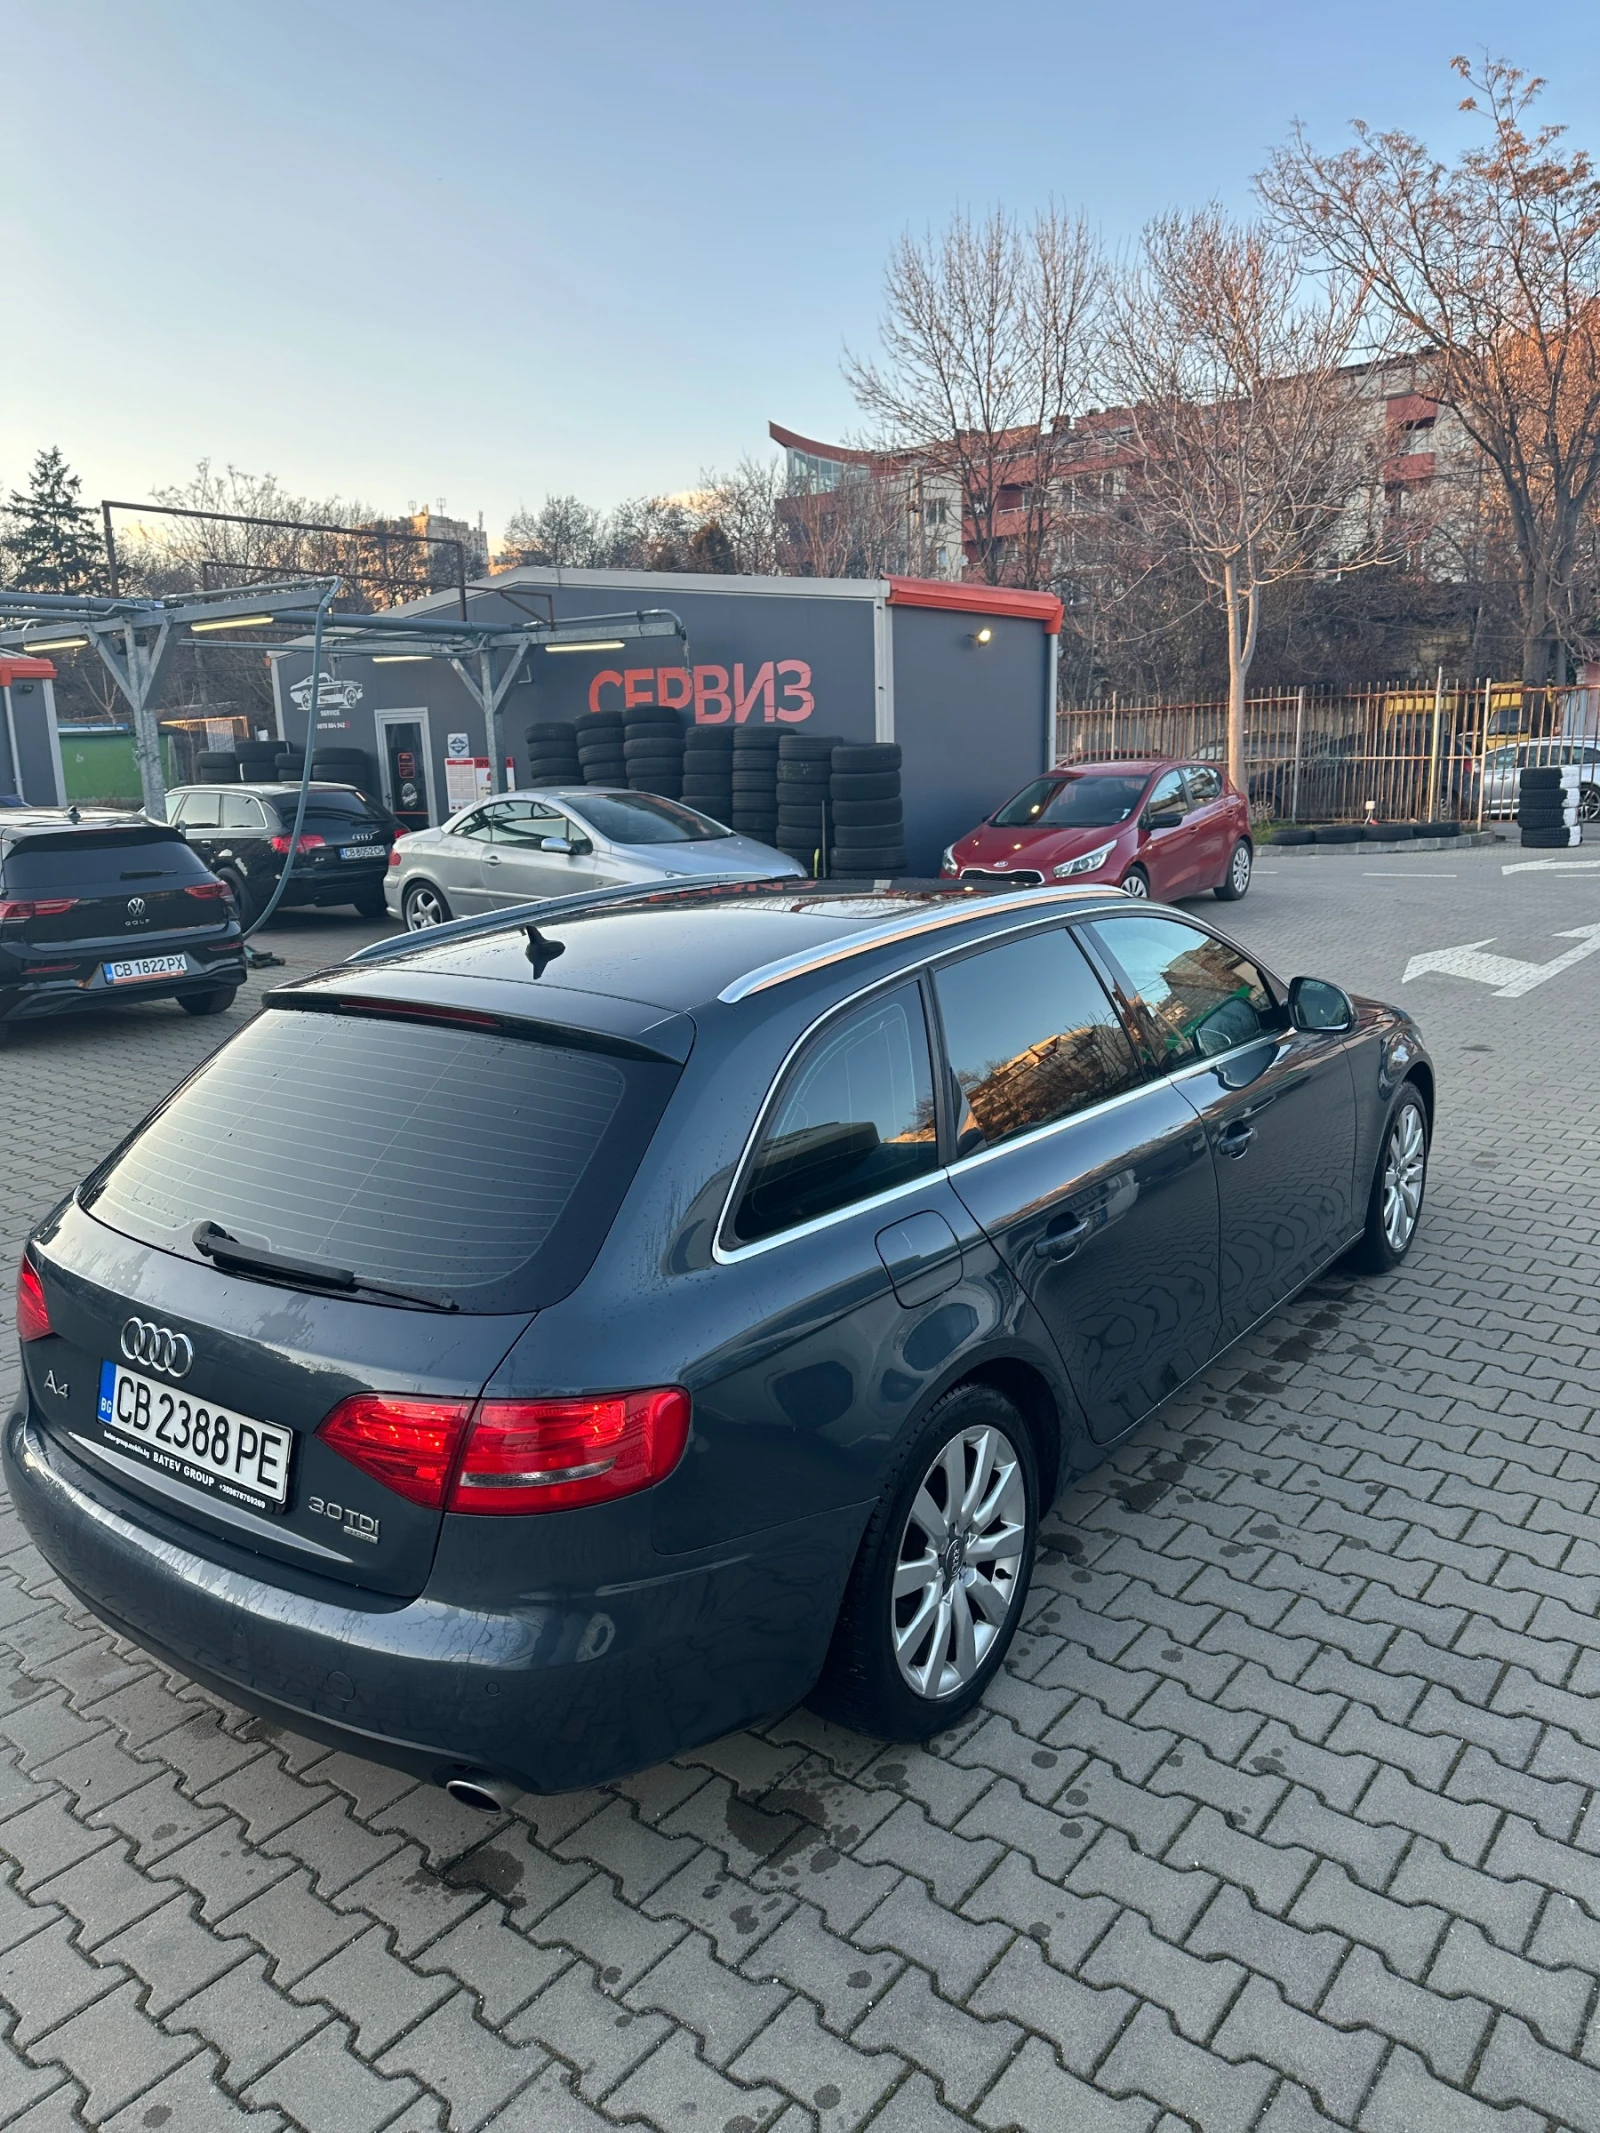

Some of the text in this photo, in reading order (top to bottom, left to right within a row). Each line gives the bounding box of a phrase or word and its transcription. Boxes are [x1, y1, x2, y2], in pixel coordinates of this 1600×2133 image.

[588, 659, 815, 724] СЕРВИЗ
[344, 848, 356, 858] CB
[125, 918, 150, 926] GOLF
[114, 956, 185, 978] CB 1822 PX
[44, 1369, 68, 1399] A4
[100, 1397, 112, 1414] BG
[116, 1376, 282, 1490] CB 2388 PE
[153, 1451, 181, 1472] BATEV
[183, 1465, 215, 1487] GROUP
[308, 1496, 343, 1520] 3.0
[344, 1508, 379, 1536] TDI
